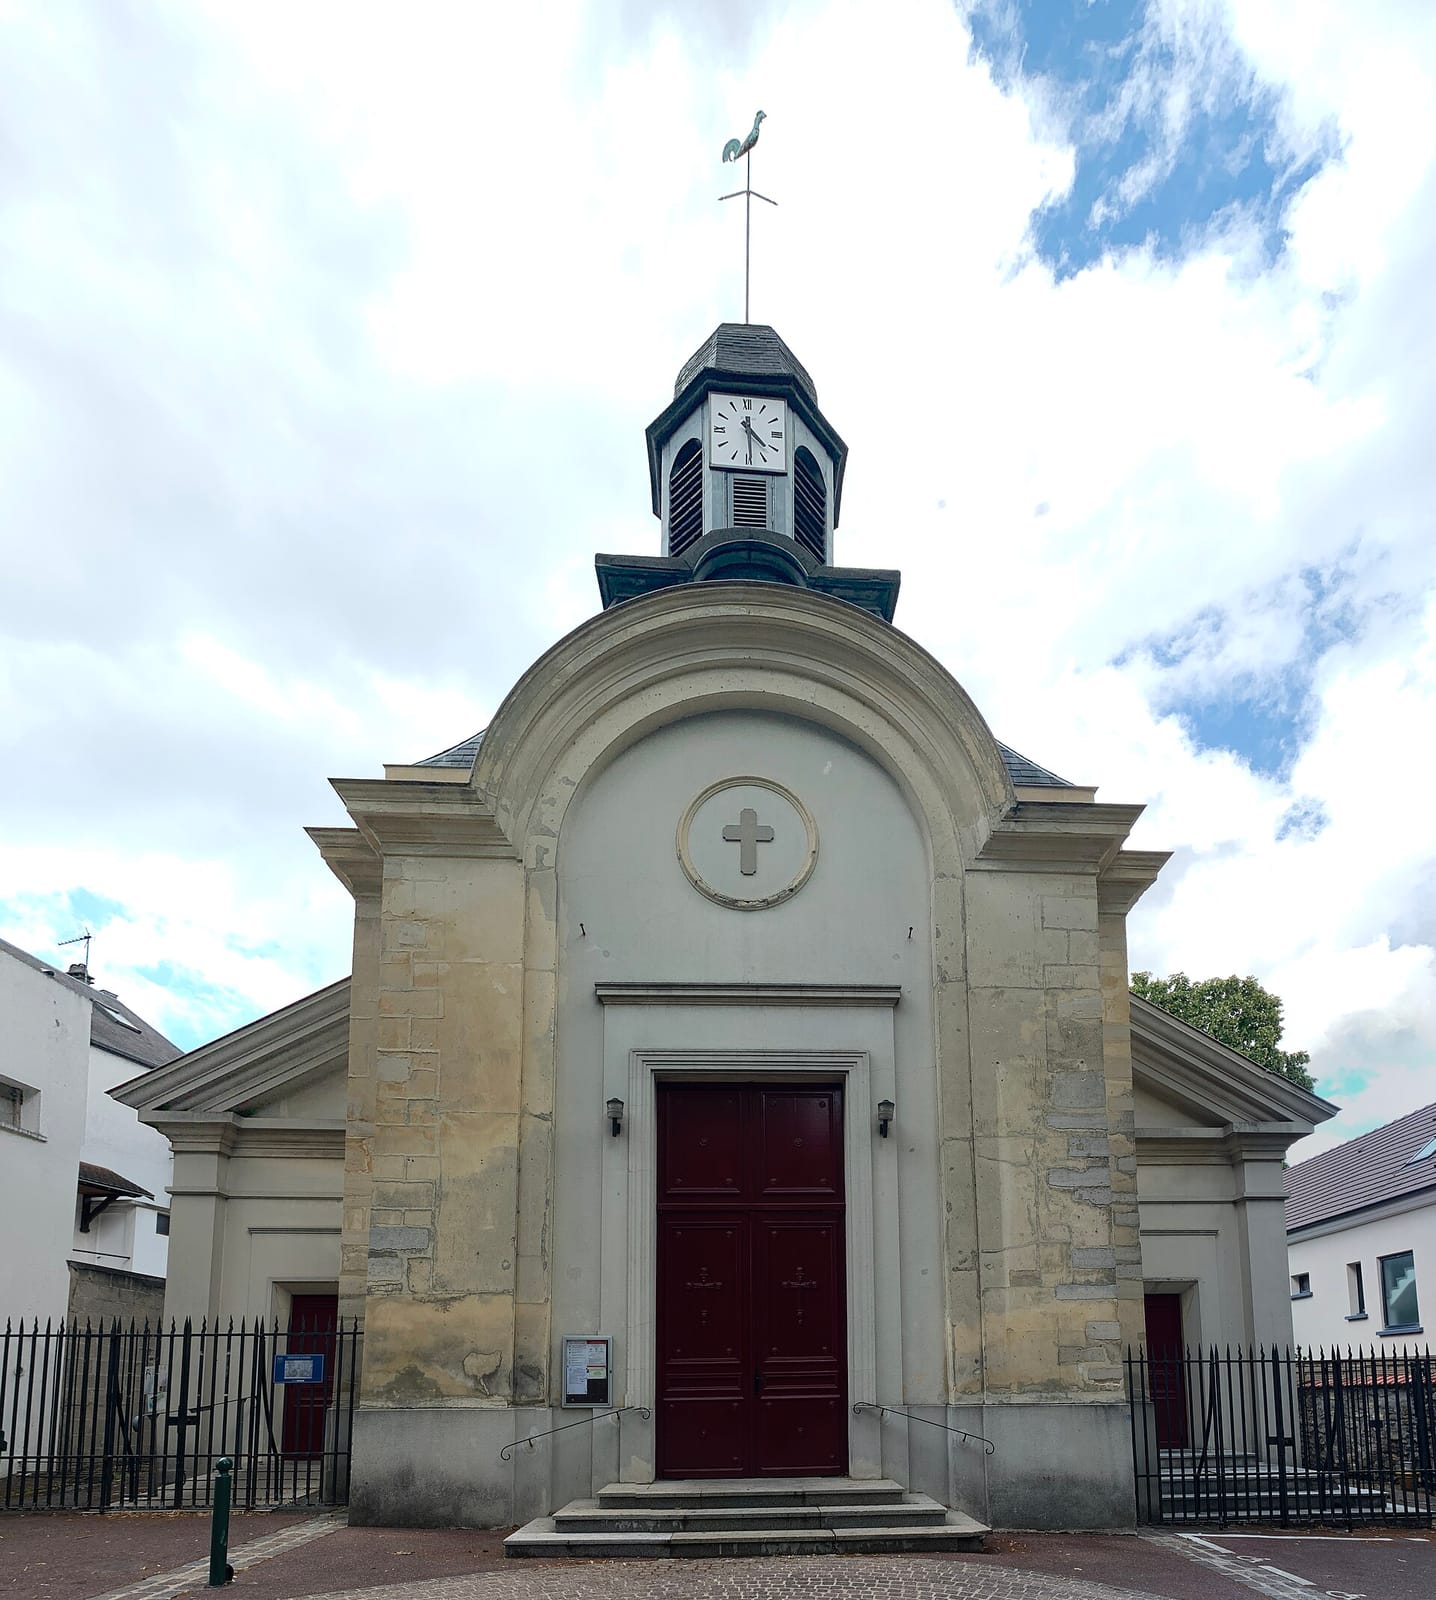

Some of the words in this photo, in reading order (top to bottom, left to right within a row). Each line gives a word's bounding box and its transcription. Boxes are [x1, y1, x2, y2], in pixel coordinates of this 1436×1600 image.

[743, 399, 752, 410] XII
[714, 425, 726, 433] IX
[771, 431, 783, 439] III
